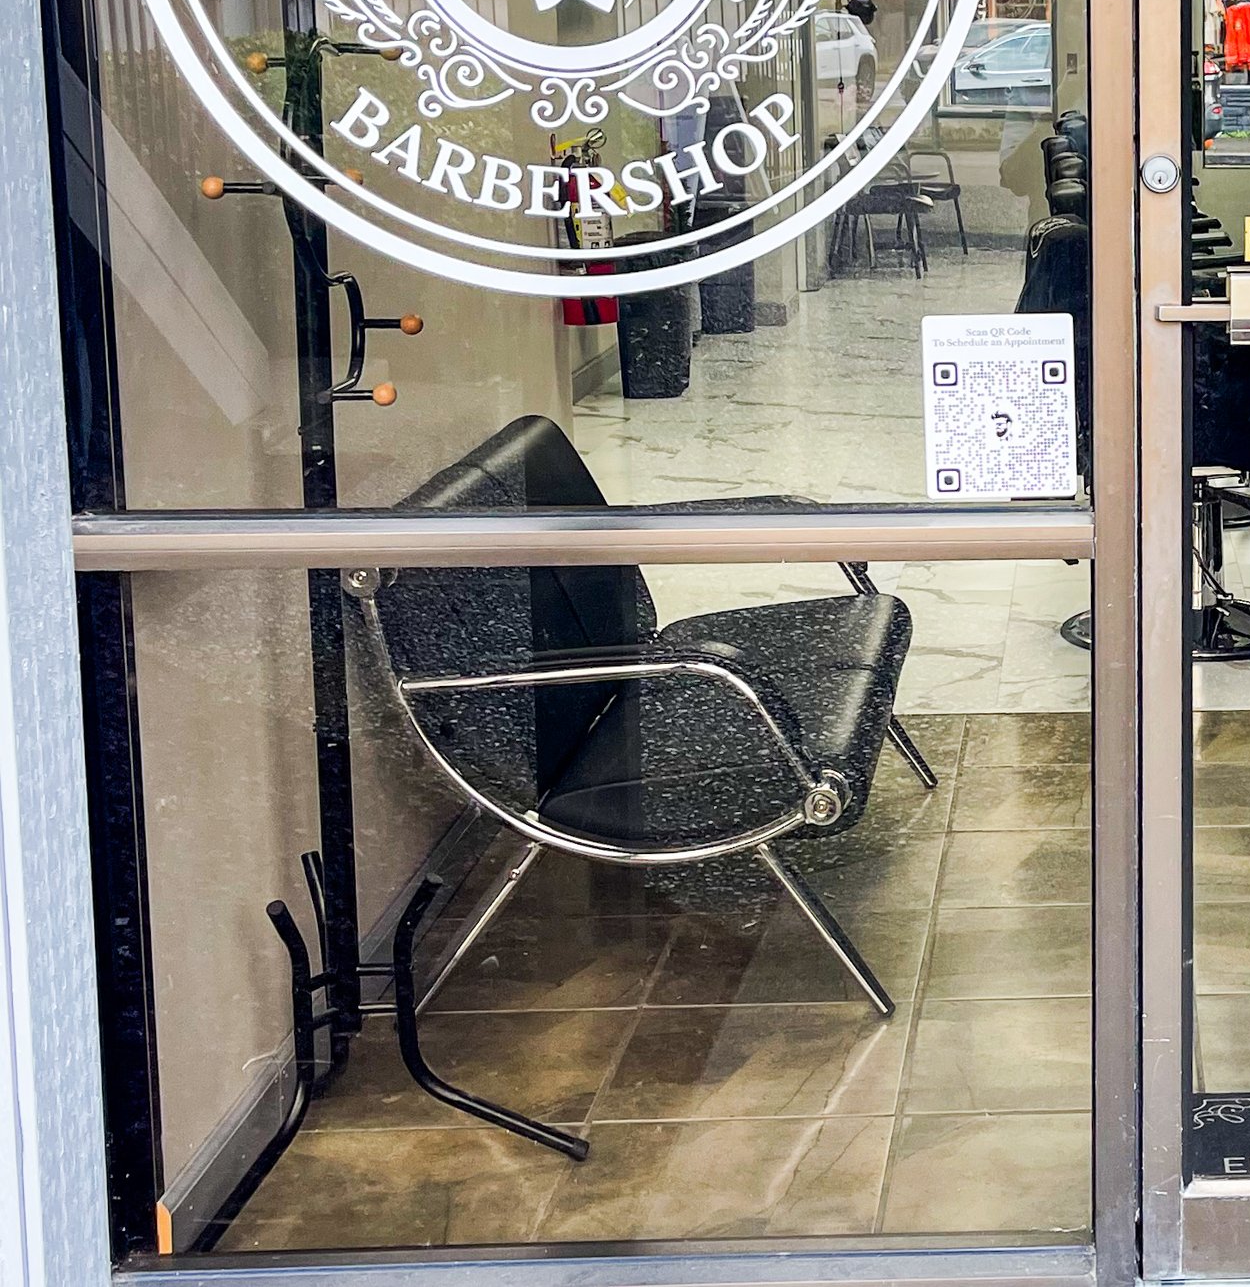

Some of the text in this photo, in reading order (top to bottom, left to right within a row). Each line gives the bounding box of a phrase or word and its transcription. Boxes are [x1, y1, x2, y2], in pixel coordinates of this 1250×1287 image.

[331, 89, 802, 217] BARBERSHOP
[966, 328, 1031, 337] Scan QR Code
[933, 339, 945, 347] To
[947, 338, 989, 347] Schedule
[1004, 338, 1065, 347] Appointment
